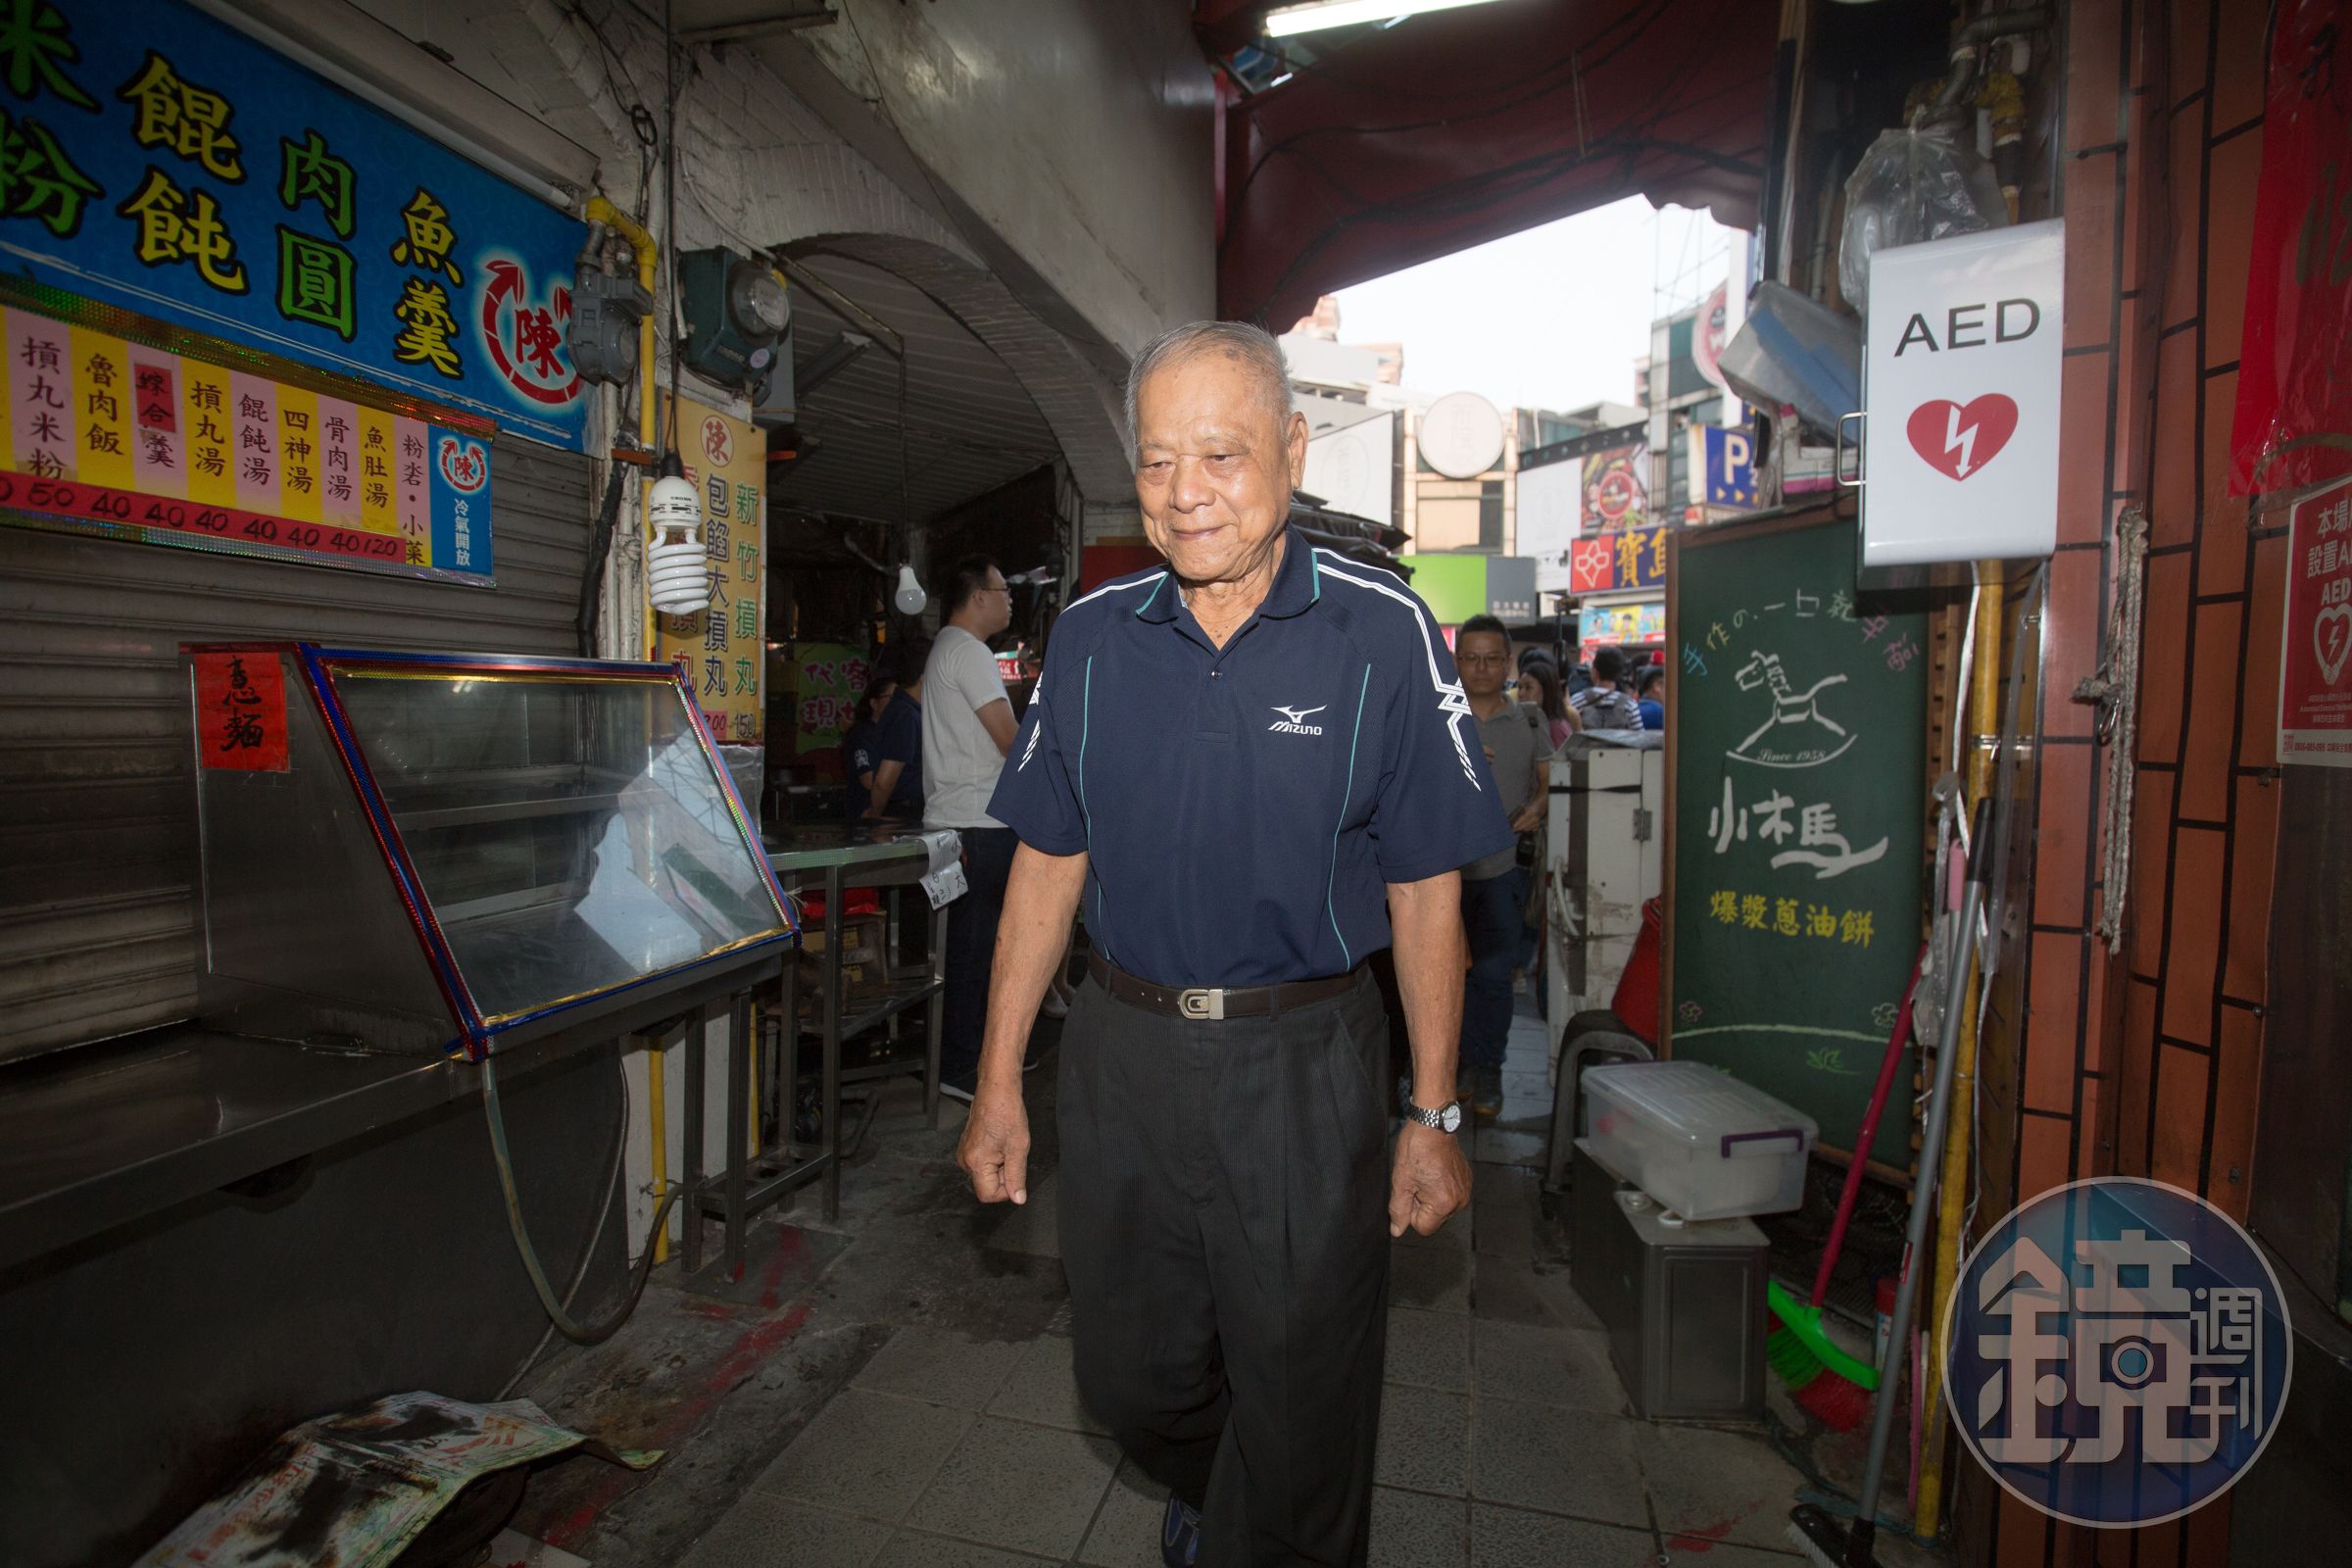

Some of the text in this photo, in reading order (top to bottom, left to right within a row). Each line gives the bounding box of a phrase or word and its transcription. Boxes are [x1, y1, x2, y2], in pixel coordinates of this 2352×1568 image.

[117, 51, 248, 292] 餛飩
[278, 130, 355, 340] 肉圓
[392, 186, 463, 378] 魚羹
[514, 308, 565, 379] 陳
[1893, 297, 2040, 357] AED
[85, 353, 124, 456] 魯肉飯
[238, 393, 270, 487] 餛飩湯
[283, 409, 314, 494] 四神湯
[324, 416, 353, 501] 骨肉湯
[364, 425, 389, 509] 魚肚湯
[454, 456, 474, 482] 陳
[706, 421, 729, 463] 陳
[1724, 433, 1750, 486] P
[28, 483, 75, 507] 50
[91, 492, 131, 518] 40
[145, 503, 184, 527] 40
[196, 511, 228, 532] 40
[244, 519, 277, 541] 40
[288, 527, 319, 546] 40
[329, 532, 360, 552] 40
[454, 498, 471, 566] 冷氣開放
[2317, 498, 2352, 539] 本場
[2307, 539, 2352, 579] 設置A
[2321, 576, 2352, 606] AED
[1268, 721, 1322, 735] MIZUNO
[1707, 775, 1889, 879] 小木馬
